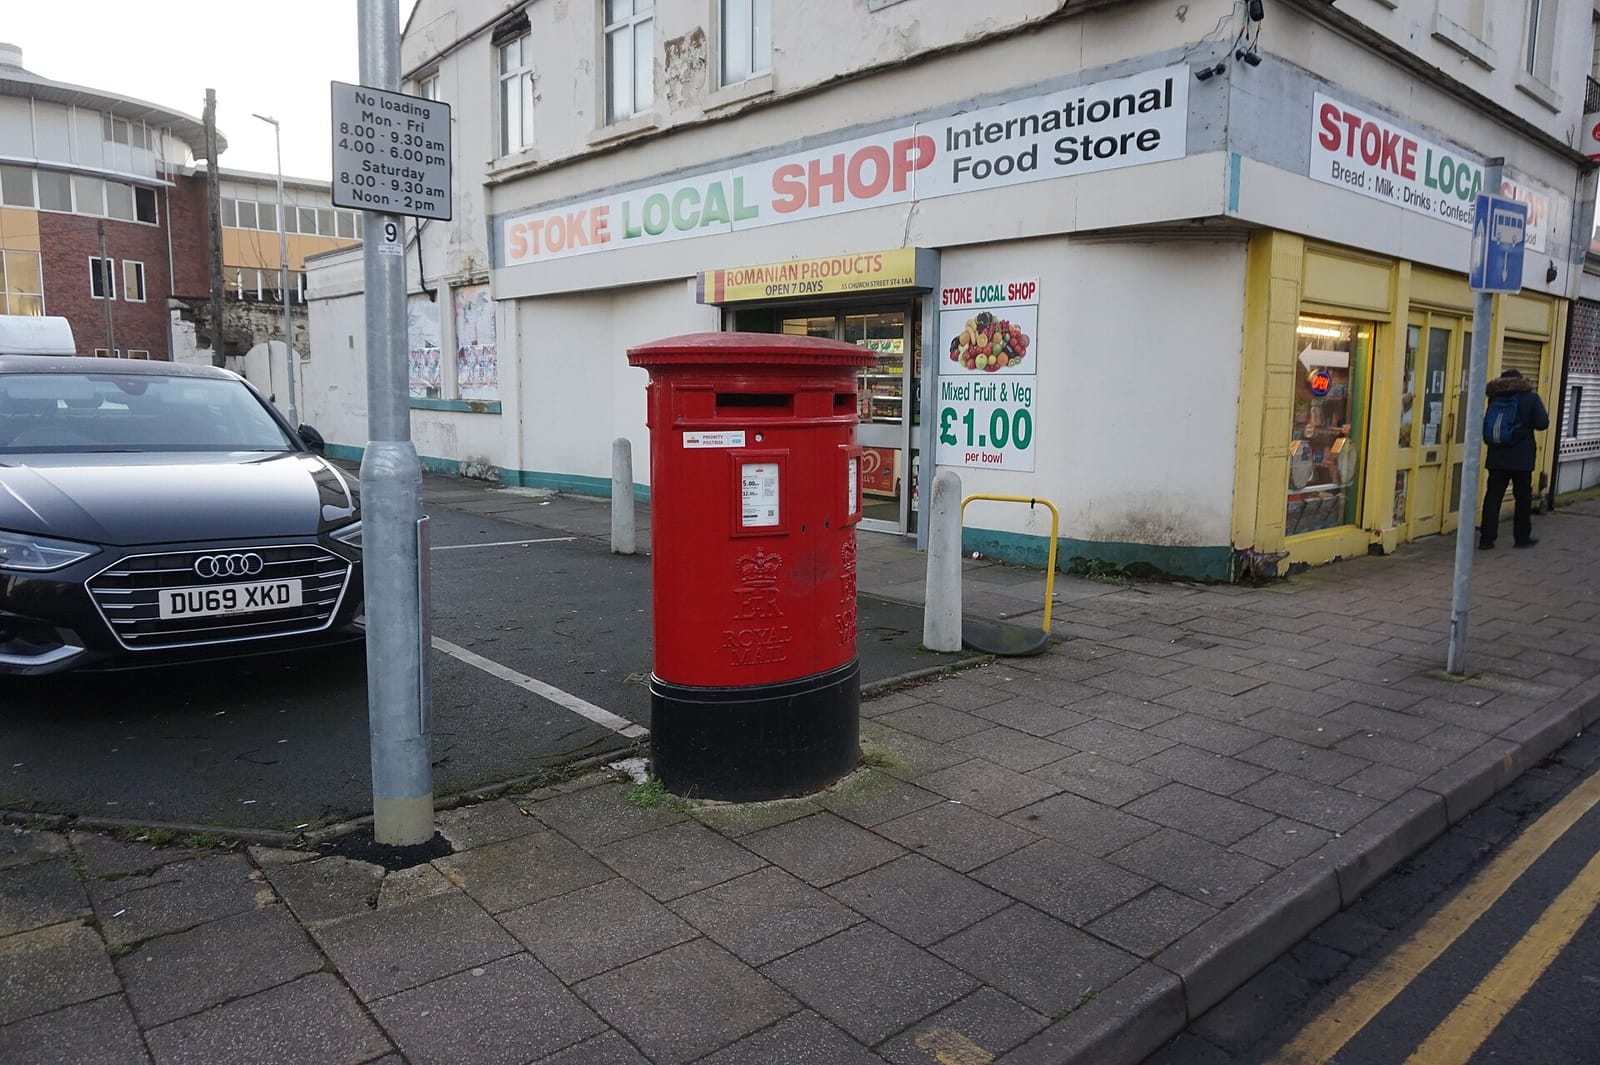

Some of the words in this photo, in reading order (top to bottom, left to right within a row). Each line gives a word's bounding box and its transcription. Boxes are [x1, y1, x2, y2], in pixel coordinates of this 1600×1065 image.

[355, 92, 375, 106] No
[381, 97, 430, 119] loading
[946, 78, 1173, 152] International
[340, 122, 375, 139] 8.00
[362, 111, 392, 127] Mon
[407, 120, 424, 133] Fri
[338, 138, 375, 154] 4.00
[953, 144, 1037, 183] Food
[1054, 127, 1161, 165] Store
[1318, 103, 1417, 181] STOKE
[1424, 149, 1484, 203] LOCA
[340, 172, 376, 188] 8.00
[362, 160, 425, 181] Saturday
[352, 189, 389, 204] Noon
[509, 205, 610, 259] STOKE
[622, 176, 759, 239] LOCAL
[771, 134, 936, 214] SHOP
[1331, 160, 1365, 187] Bread
[1375, 176, 1394, 198] Milk
[1403, 186, 1431, 210] Drinks
[1440, 200, 1475, 224] Confecti
[385, 223, 397, 242] 9
[727, 264, 798, 286] ROMANIAN
[801, 254, 883, 279] PRODUCTS
[765, 283, 789, 296] OPEN
[791, 283, 797, 293] 7
[799, 280, 824, 293] DAYS
[870, 279, 889, 287] STREET
[890, 278, 900, 286] ST4
[943, 287, 972, 306] STOKE
[974, 284, 1006, 303] LOCAL
[1008, 281, 1036, 301] SHOP
[1311, 375, 1329, 390] OPEN
[942, 381, 970, 401] Mixed
[974, 381, 996, 402] Fruit
[1000, 384, 1008, 402] &
[1012, 382, 1032, 408] Veg
[939, 406, 1033, 450] £1.00
[965, 452, 979, 464] per
[982, 451, 1003, 464] bowl
[170, 588, 237, 614] DU69
[245, 584, 290, 608] XKD
[722, 626, 792, 648] ROYAL
[729, 645, 788, 666] MAIL
